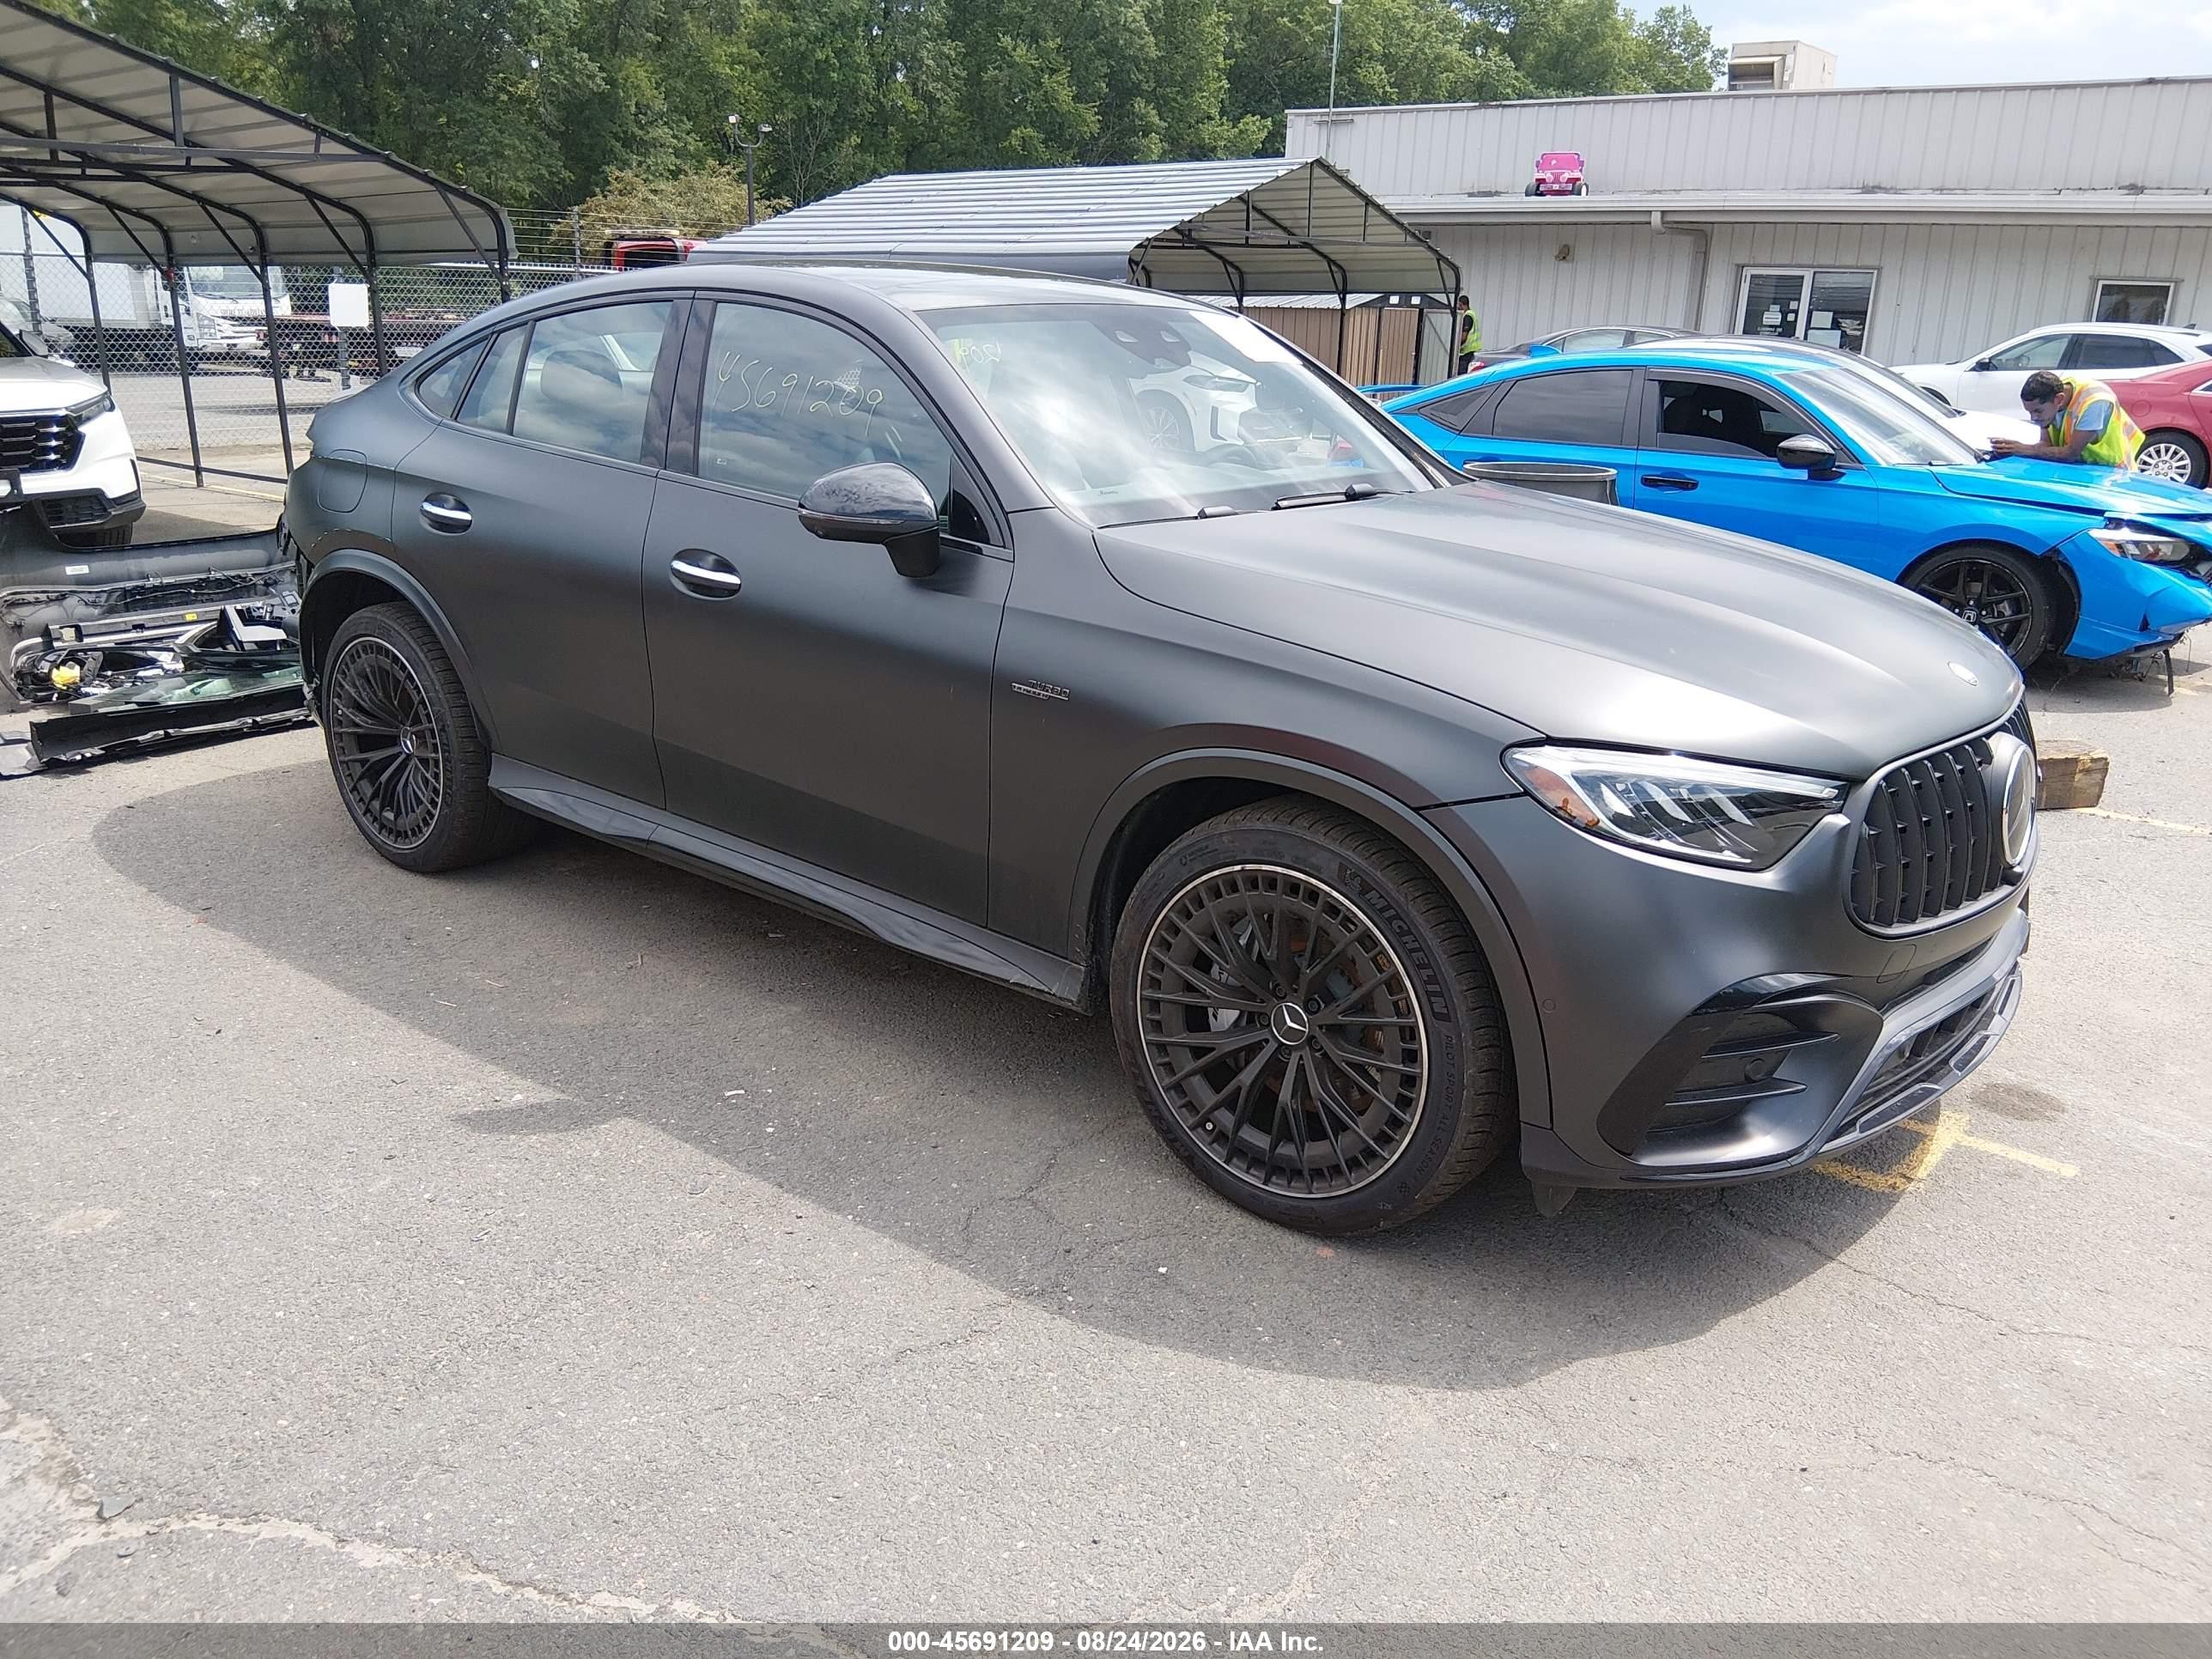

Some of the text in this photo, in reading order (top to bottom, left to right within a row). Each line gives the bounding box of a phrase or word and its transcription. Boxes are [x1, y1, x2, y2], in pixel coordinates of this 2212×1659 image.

[713, 350, 884, 436] 45691209
[1028, 679, 1070, 697] TURBO
[1365, 889, 1449, 1020] MICHELIN
[1416, 1035, 1456, 1176] PILOT SPORT ALL SEASON
